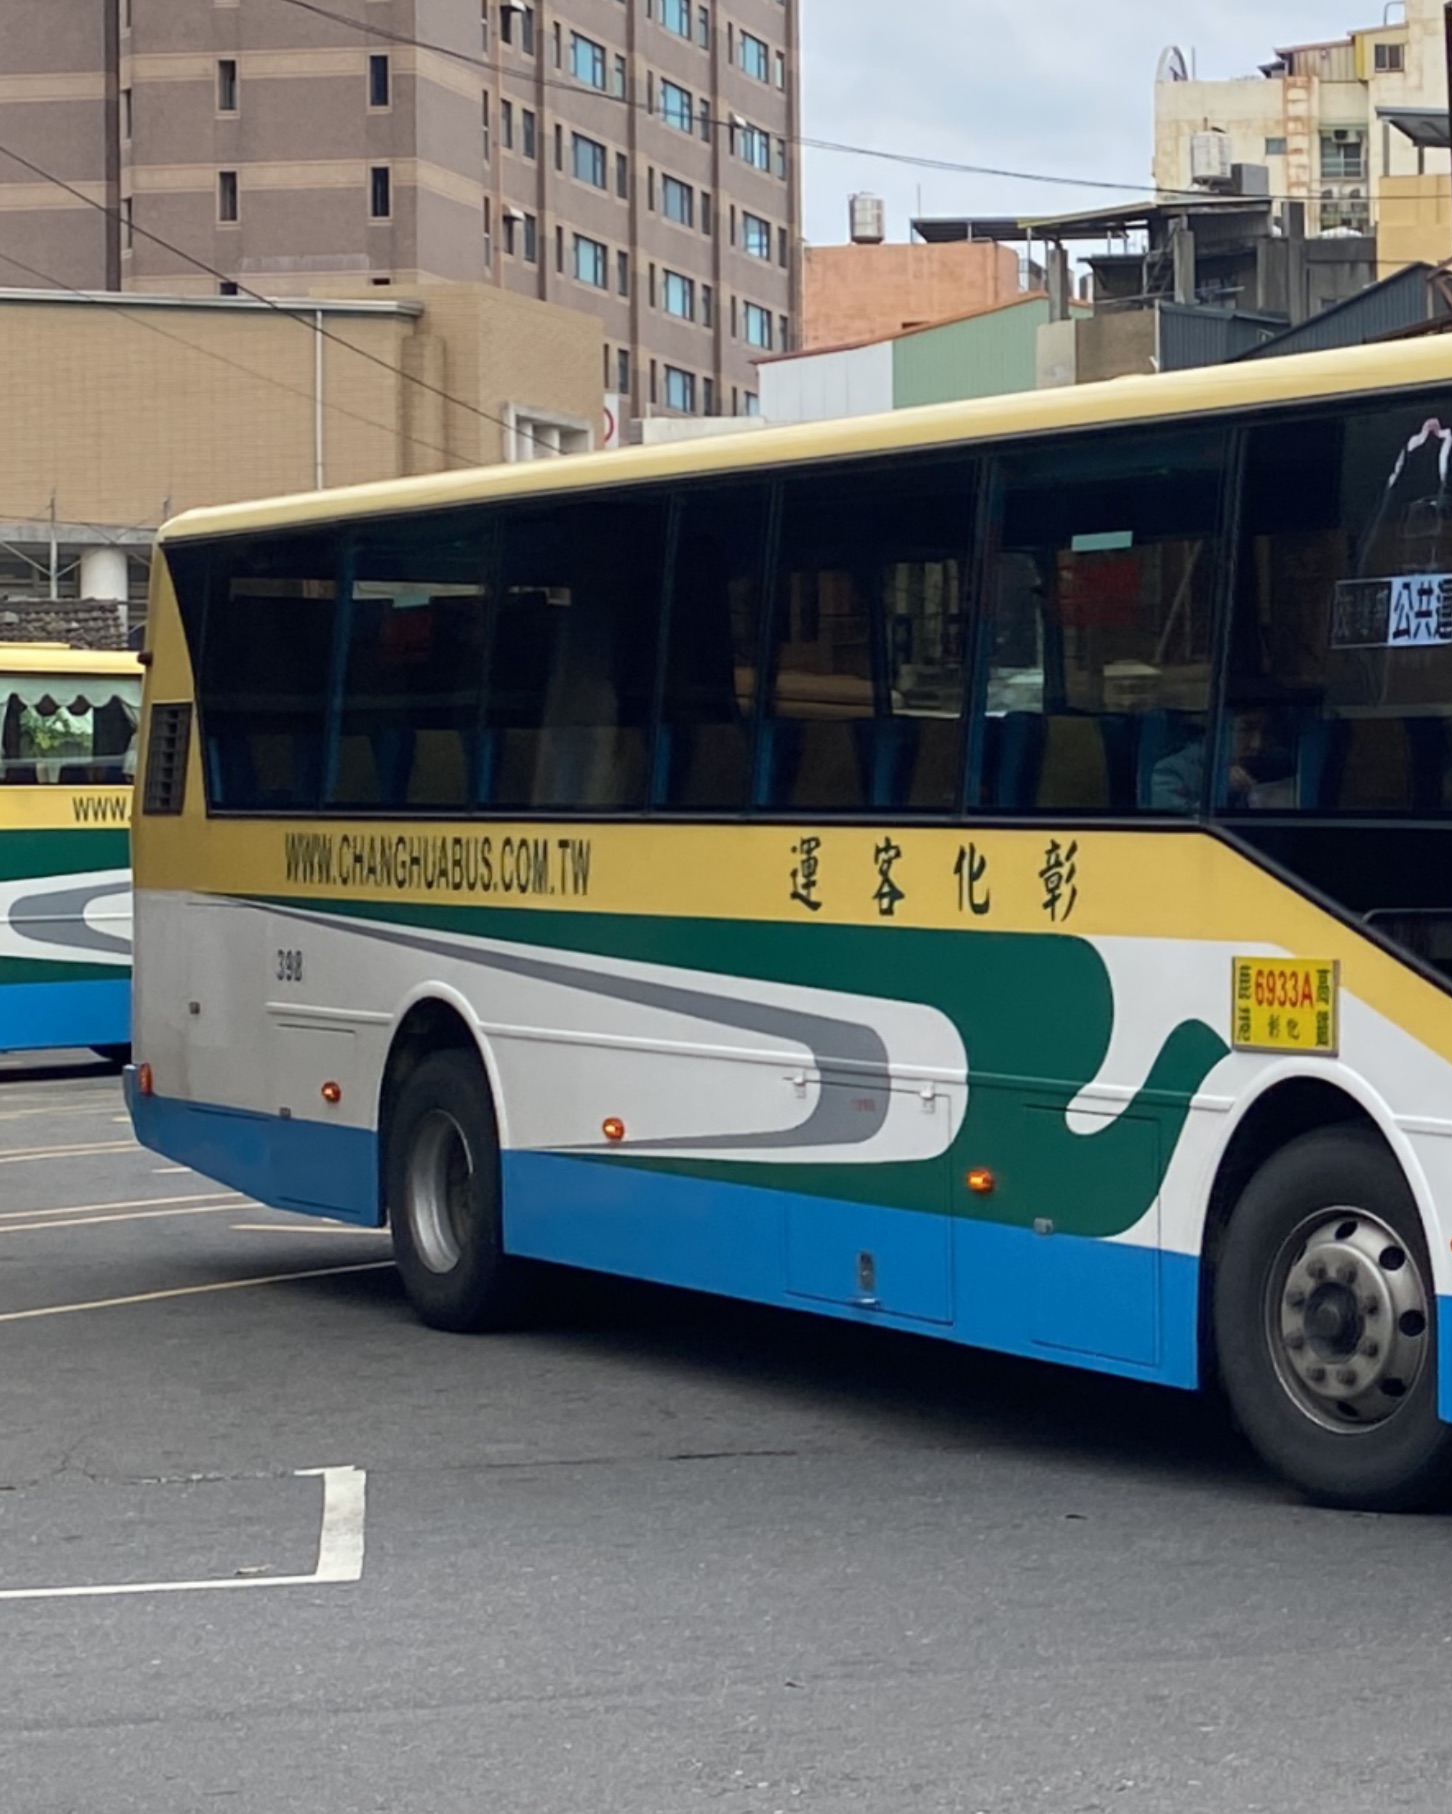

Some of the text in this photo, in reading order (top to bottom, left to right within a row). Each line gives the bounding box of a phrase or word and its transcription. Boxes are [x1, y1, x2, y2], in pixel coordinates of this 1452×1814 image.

[284, 832, 592, 897] WWW.CHANGHUABUS.COM.TW
[276, 948, 303, 982] 398
[1254, 968, 1315, 1009] 6933A
